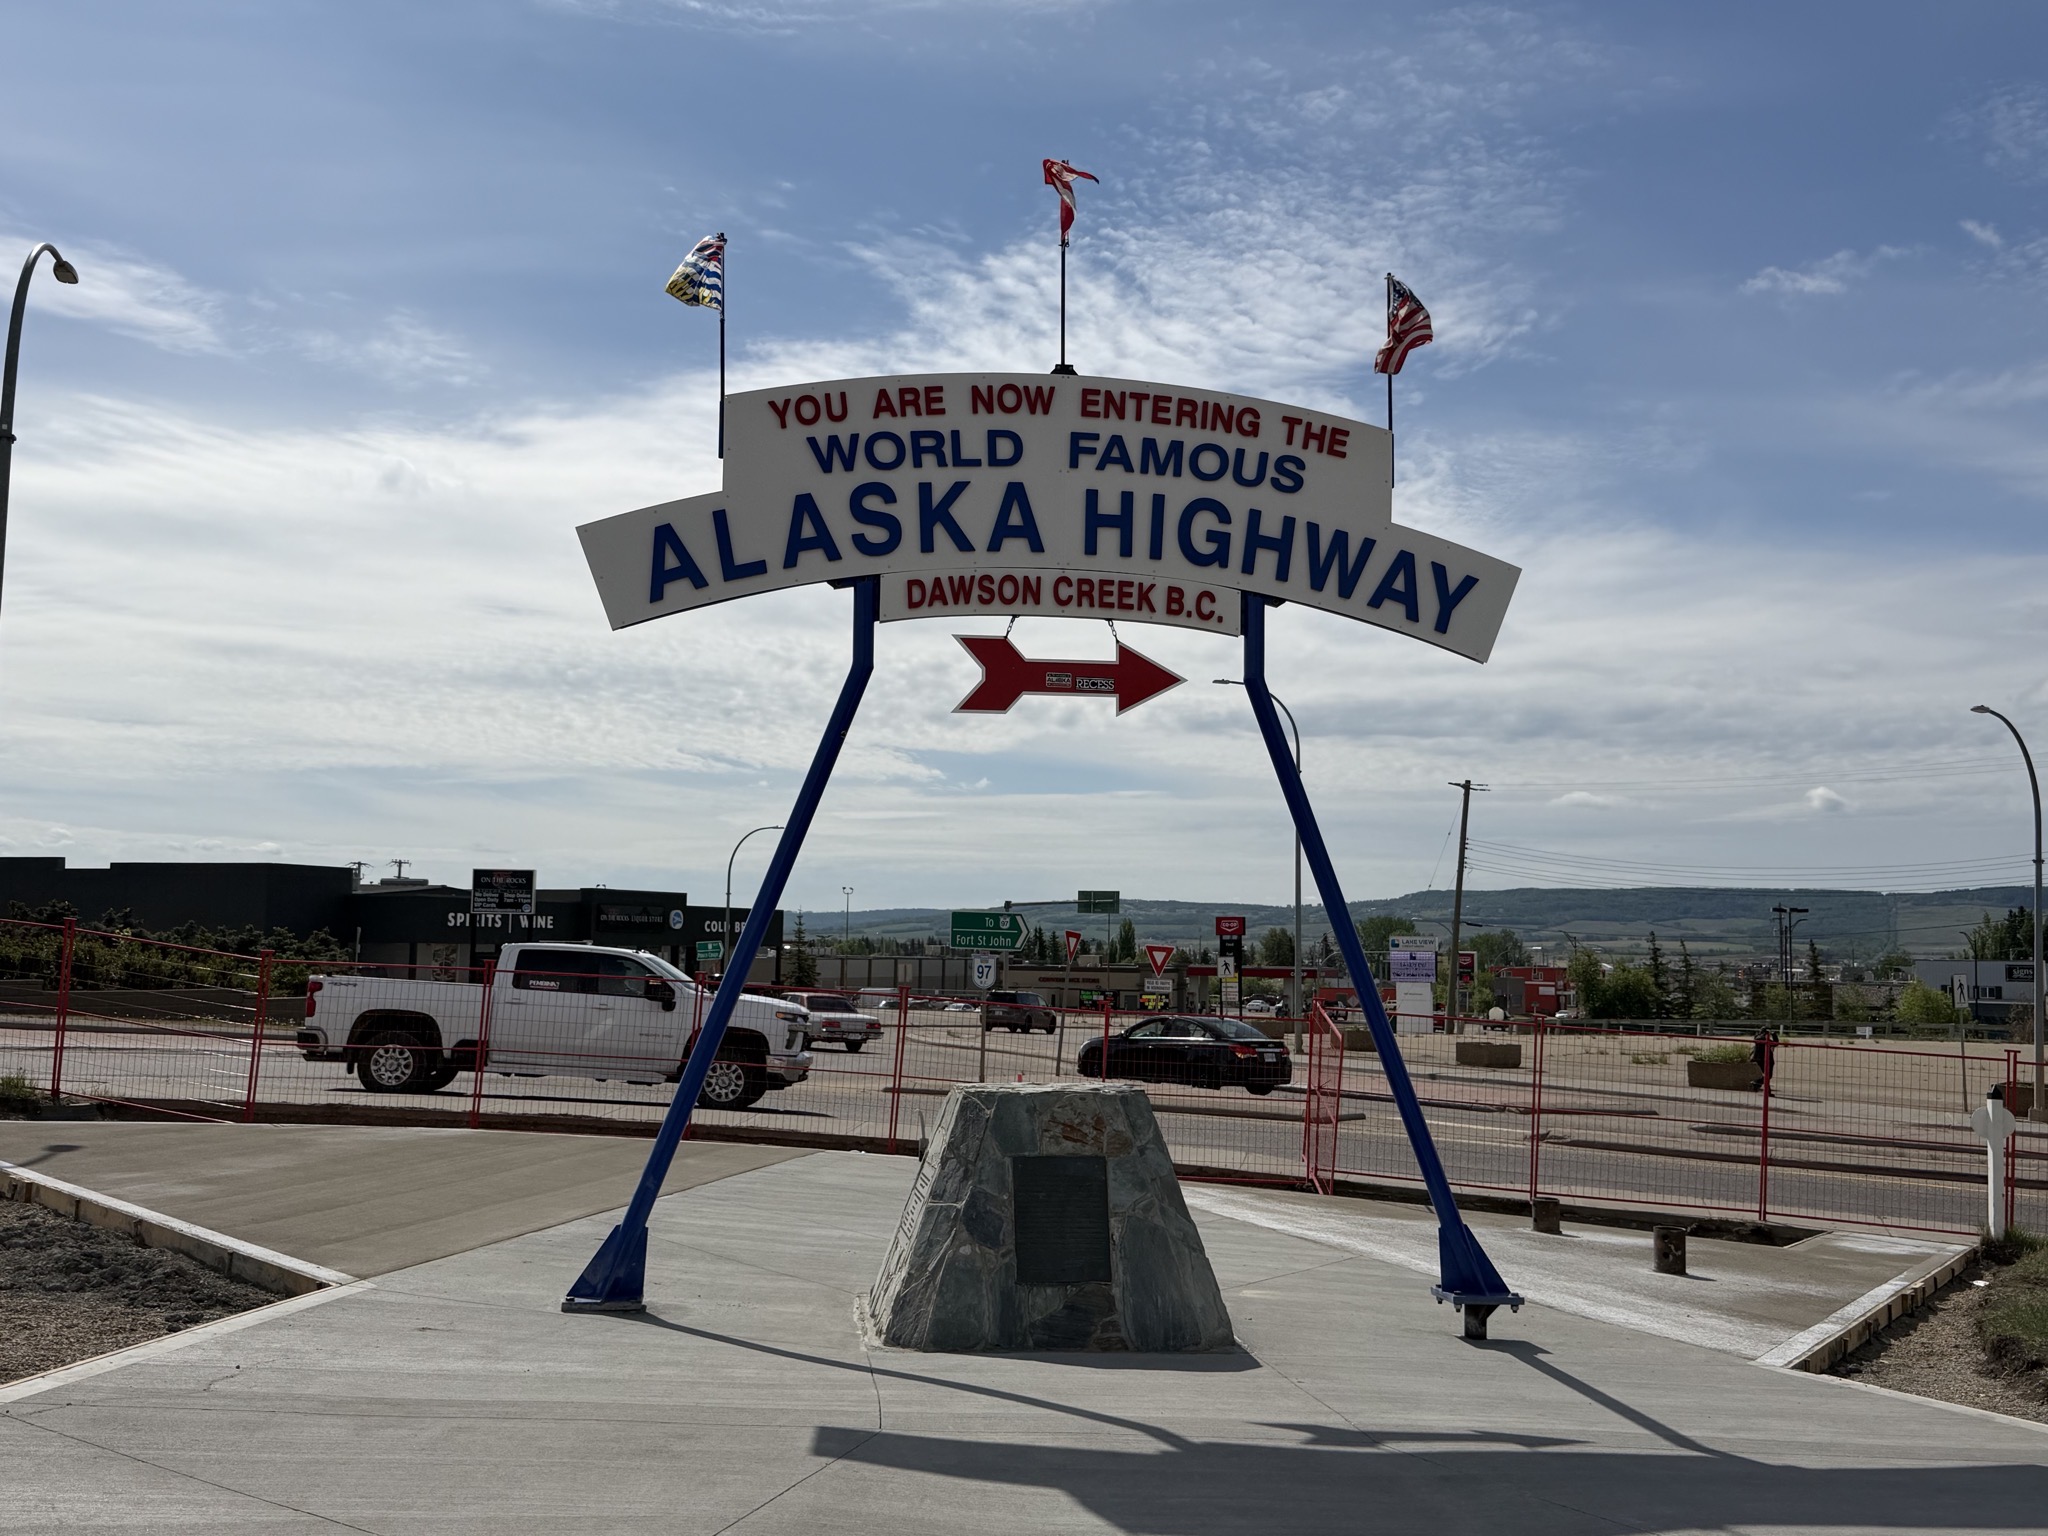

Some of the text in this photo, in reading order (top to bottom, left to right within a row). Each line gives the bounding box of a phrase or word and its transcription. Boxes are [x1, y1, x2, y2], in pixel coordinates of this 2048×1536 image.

[768, 384, 1351, 459] YOU ARE NOW ENTERING THE
[806, 429, 1306, 494] WORLD FAMOUS
[649, 481, 1480, 635] ALASKA HIGHWAY
[907, 574, 1224, 623] DAWSON CREEK B.C.
[1076, 679, 1115, 690] RECESS
[985, 917, 994, 927] To
[956, 934, 1011, 947] Fort St John
[977, 964, 992, 980] 97
[2012, 966, 2033, 976] signs
